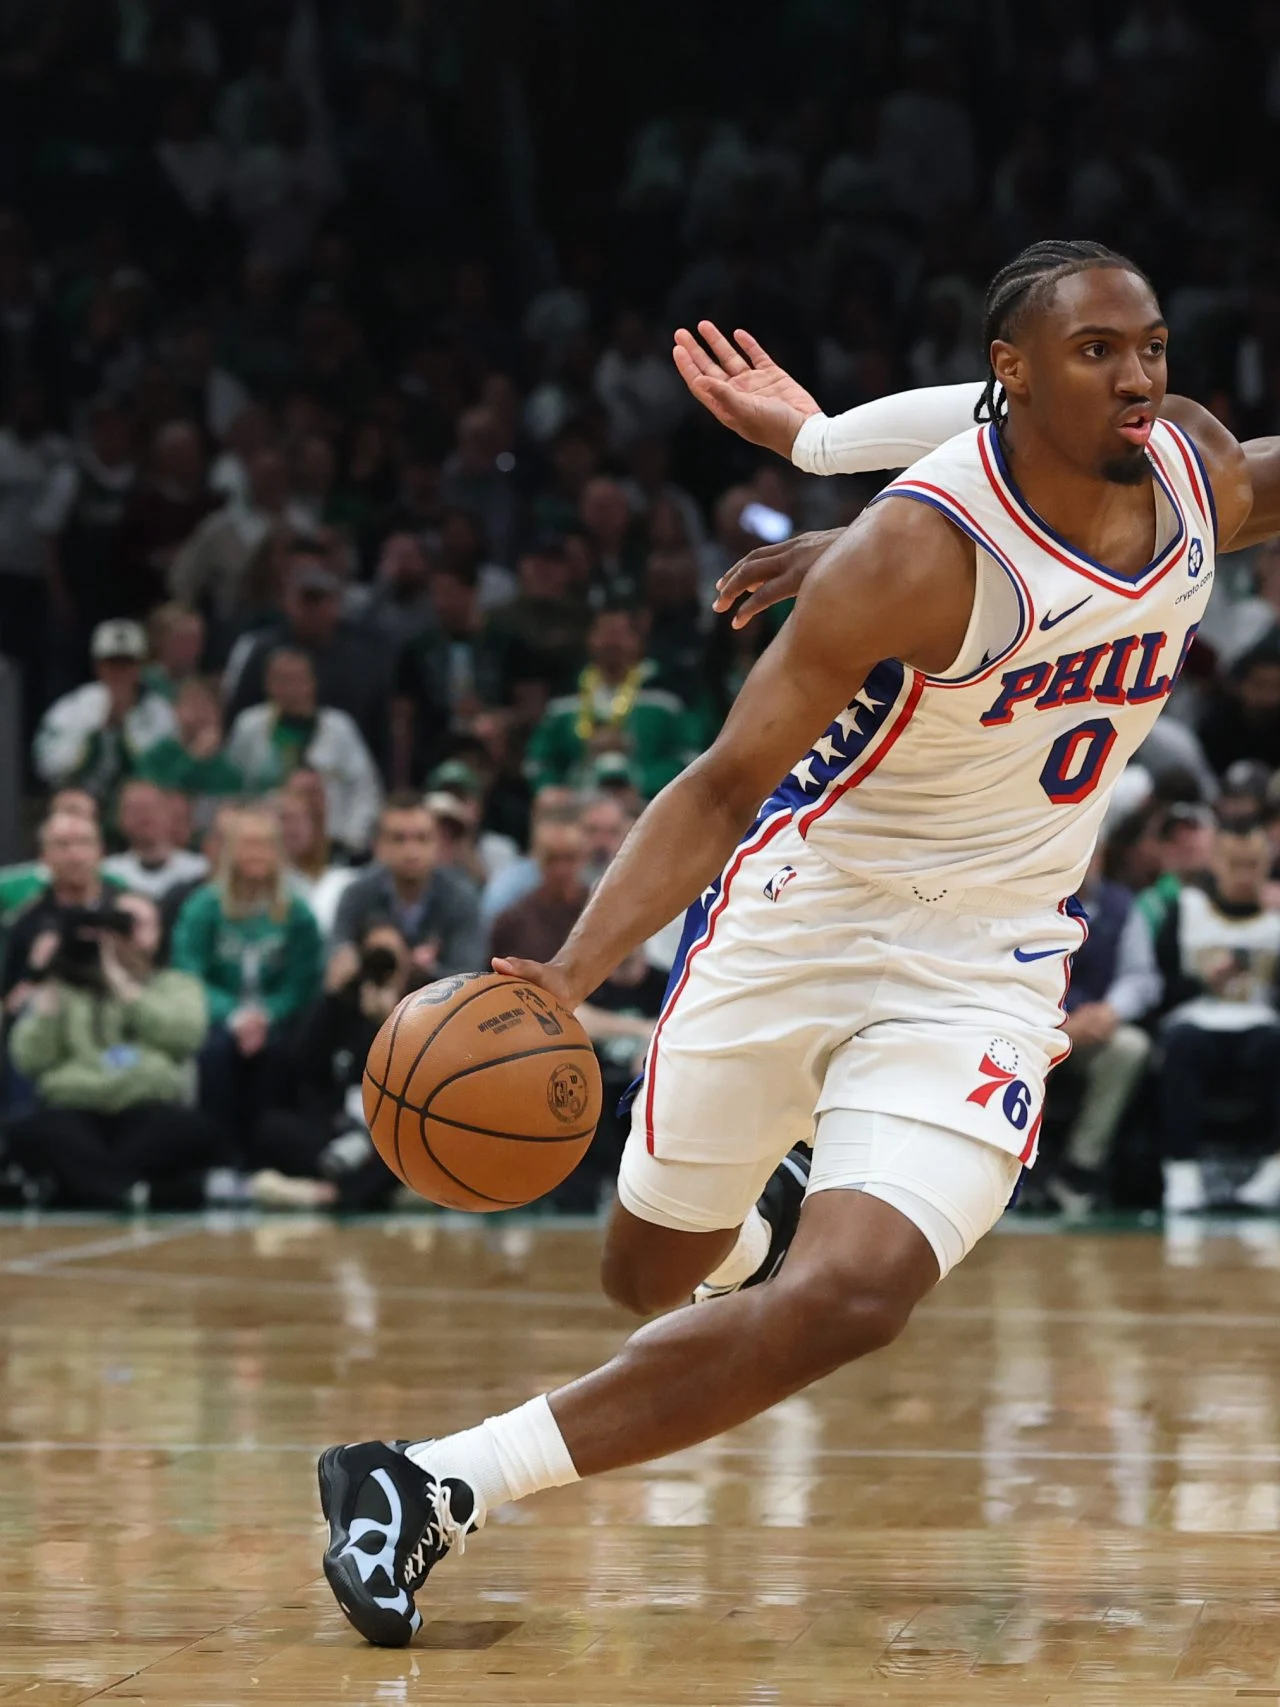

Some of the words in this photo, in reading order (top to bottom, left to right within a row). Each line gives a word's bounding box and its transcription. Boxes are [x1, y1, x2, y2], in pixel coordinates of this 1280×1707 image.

[1174, 569, 1213, 605] crypto.com
[1039, 717, 1118, 805] 0
[966, 1051, 1032, 1130] 76
